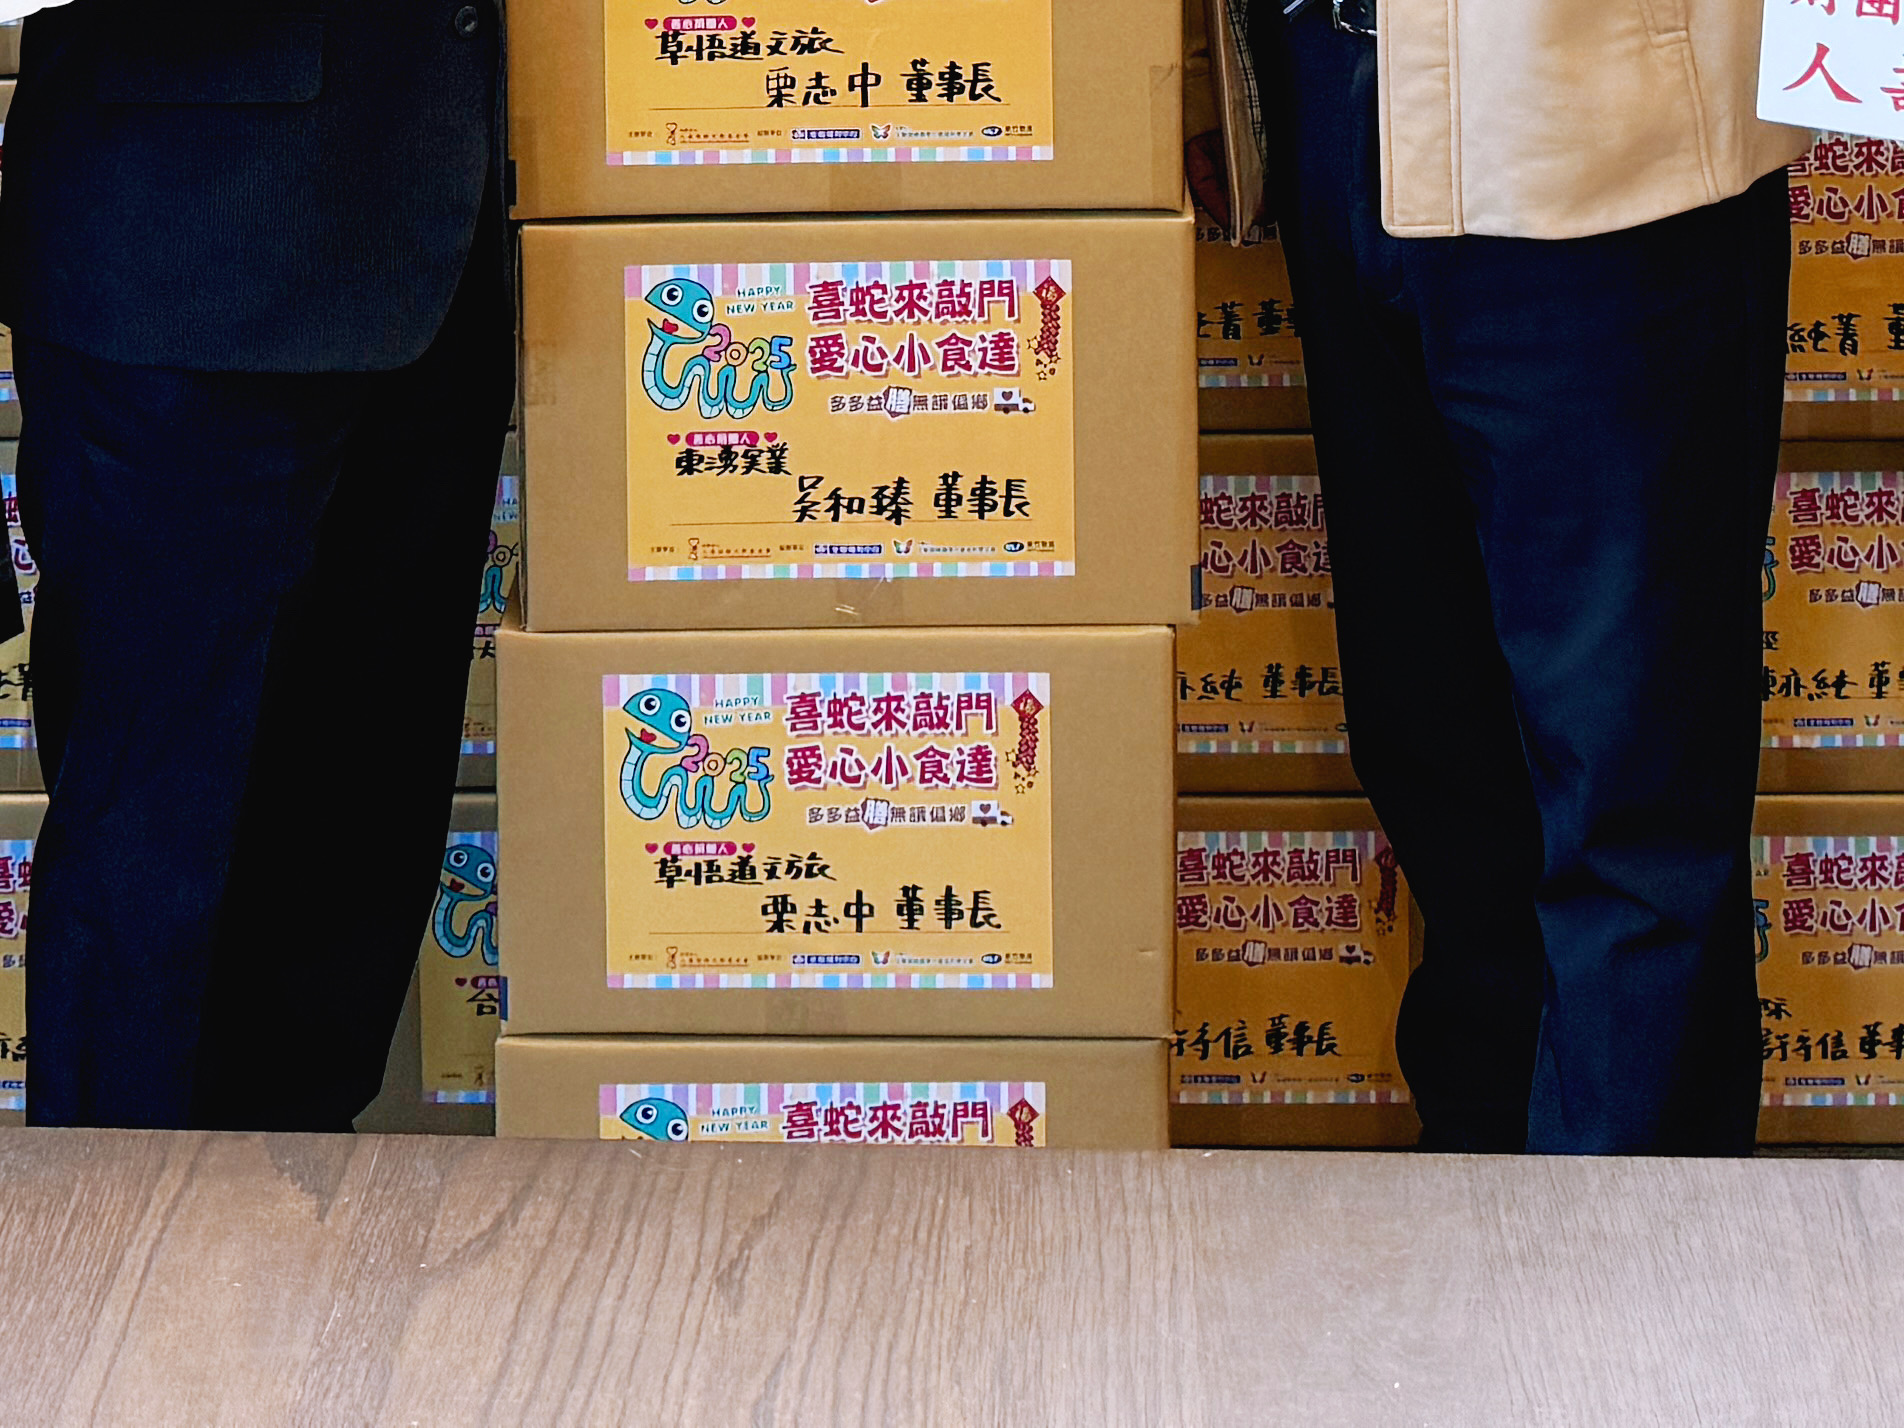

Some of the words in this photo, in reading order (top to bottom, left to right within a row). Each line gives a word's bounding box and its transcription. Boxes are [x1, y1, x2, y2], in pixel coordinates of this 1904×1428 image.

[900, 56, 1002, 104] 董事長
[808, 279, 1016, 319] 喜蛇來敲門
[704, 322, 795, 367] 2025
[808, 330, 1017, 375] 愛心小食達
[932, 470, 1031, 520] 董事長
[785, 692, 994, 732] 喜蛇來敲門
[682, 733, 773, 777] 2025
[785, 743, 995, 786] 愛心小食達
[1175, 848, 1359, 883] 喜蛇來敲門
[894, 883, 1002, 931] 董事長
[1175, 892, 1359, 929] 愛心小食達
[782, 1100, 990, 1139] 喜蛇來敲門
